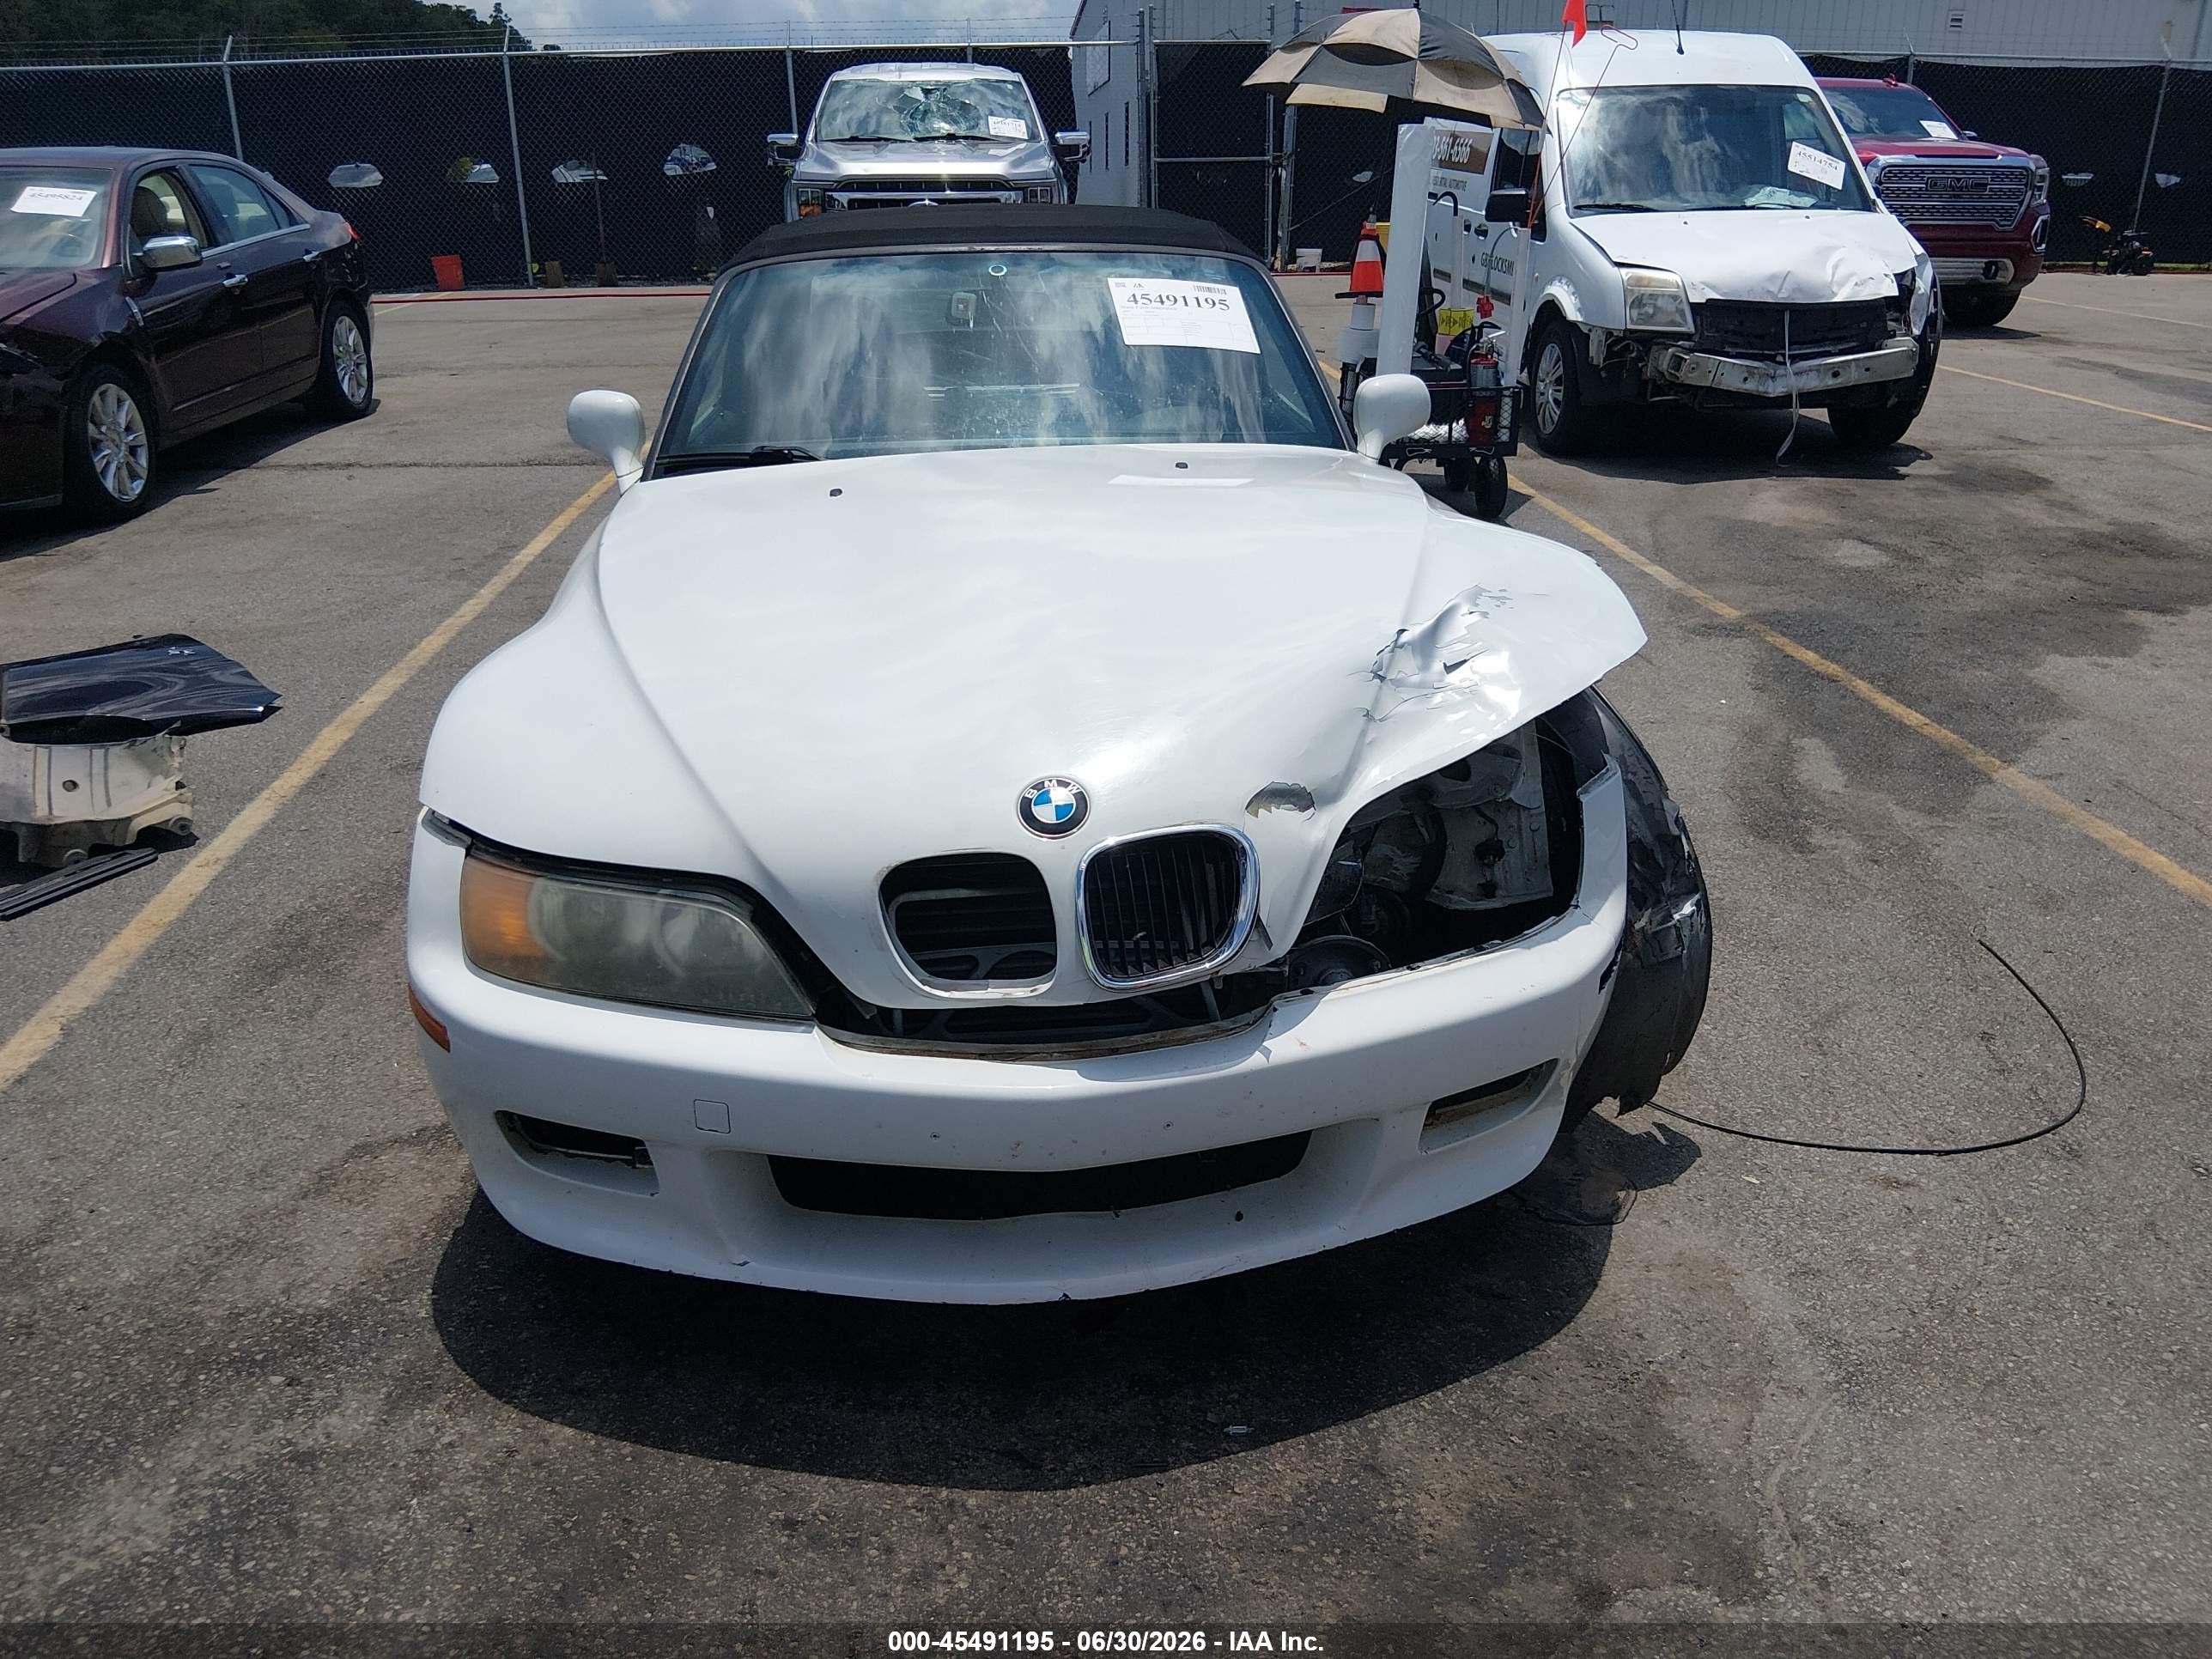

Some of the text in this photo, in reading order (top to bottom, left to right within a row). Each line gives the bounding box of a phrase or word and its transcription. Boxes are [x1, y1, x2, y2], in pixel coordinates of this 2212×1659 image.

[1928, 178, 1988, 191] GMC
[1127, 293, 1230, 311] 45491195
[1024, 779, 1083, 799] BMW
